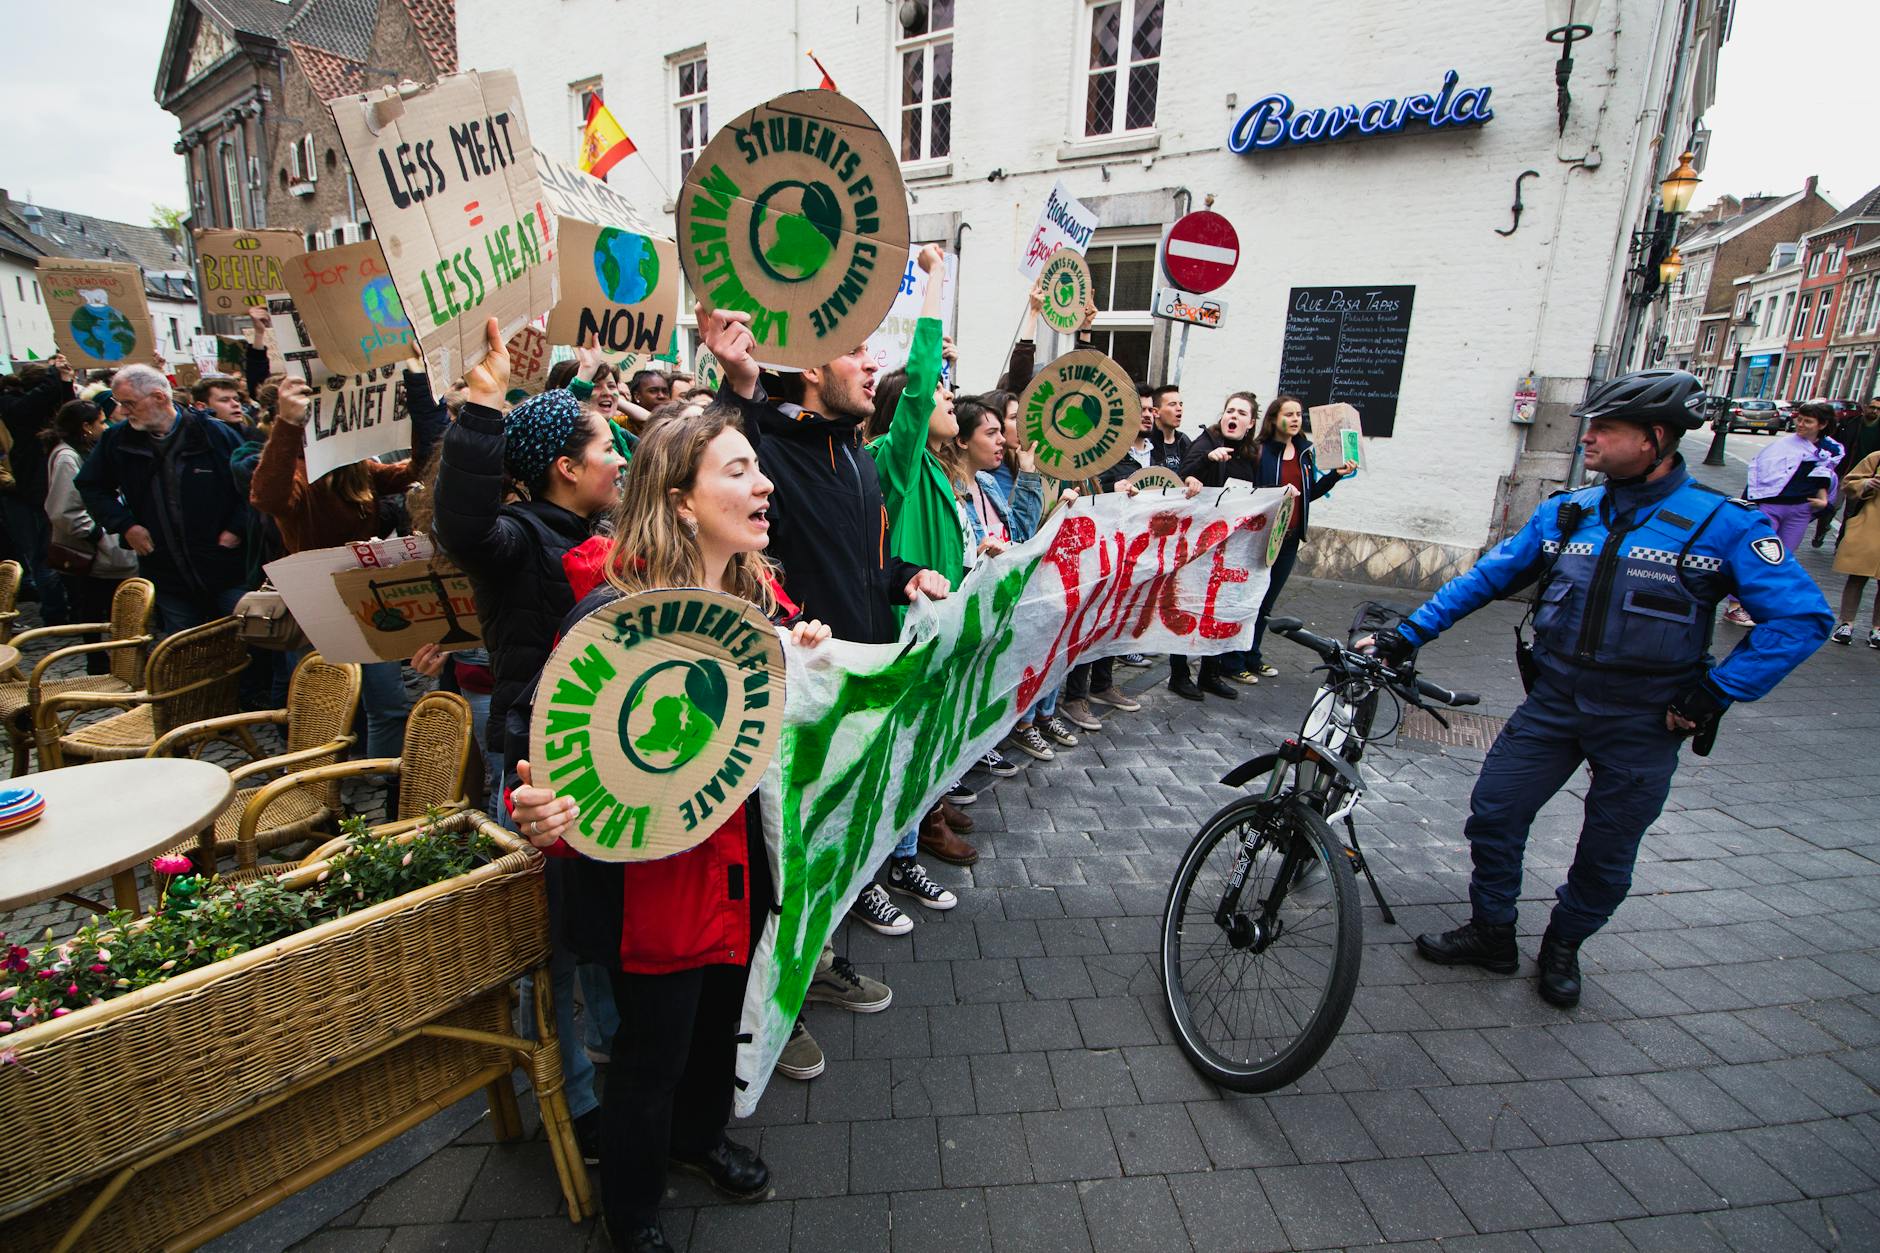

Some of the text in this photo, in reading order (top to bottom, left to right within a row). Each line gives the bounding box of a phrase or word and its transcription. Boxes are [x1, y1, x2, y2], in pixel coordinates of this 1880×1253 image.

[1228, 69, 1494, 154] Bavaria
[377, 113, 516, 209] LESS MEAT
[420, 201, 554, 327] LESS HEAT!
[735, 117, 880, 338] STUDENTS FOR CLIMATE
[304, 256, 384, 294] for a
[1324, 290, 1360, 312] PASA
[1366, 291, 1400, 312] TAPAS
[576, 307, 663, 352] NOW
[1059, 364, 1124, 469] STUDENTS FOR CLIMATE
[451, 580, 469, 591] IS
[1626, 567, 1677, 584] HANDHAVING
[545, 643, 651, 849] MAASTRICHT
[613, 601, 770, 832] STUDENTS FOR CLIMATE
